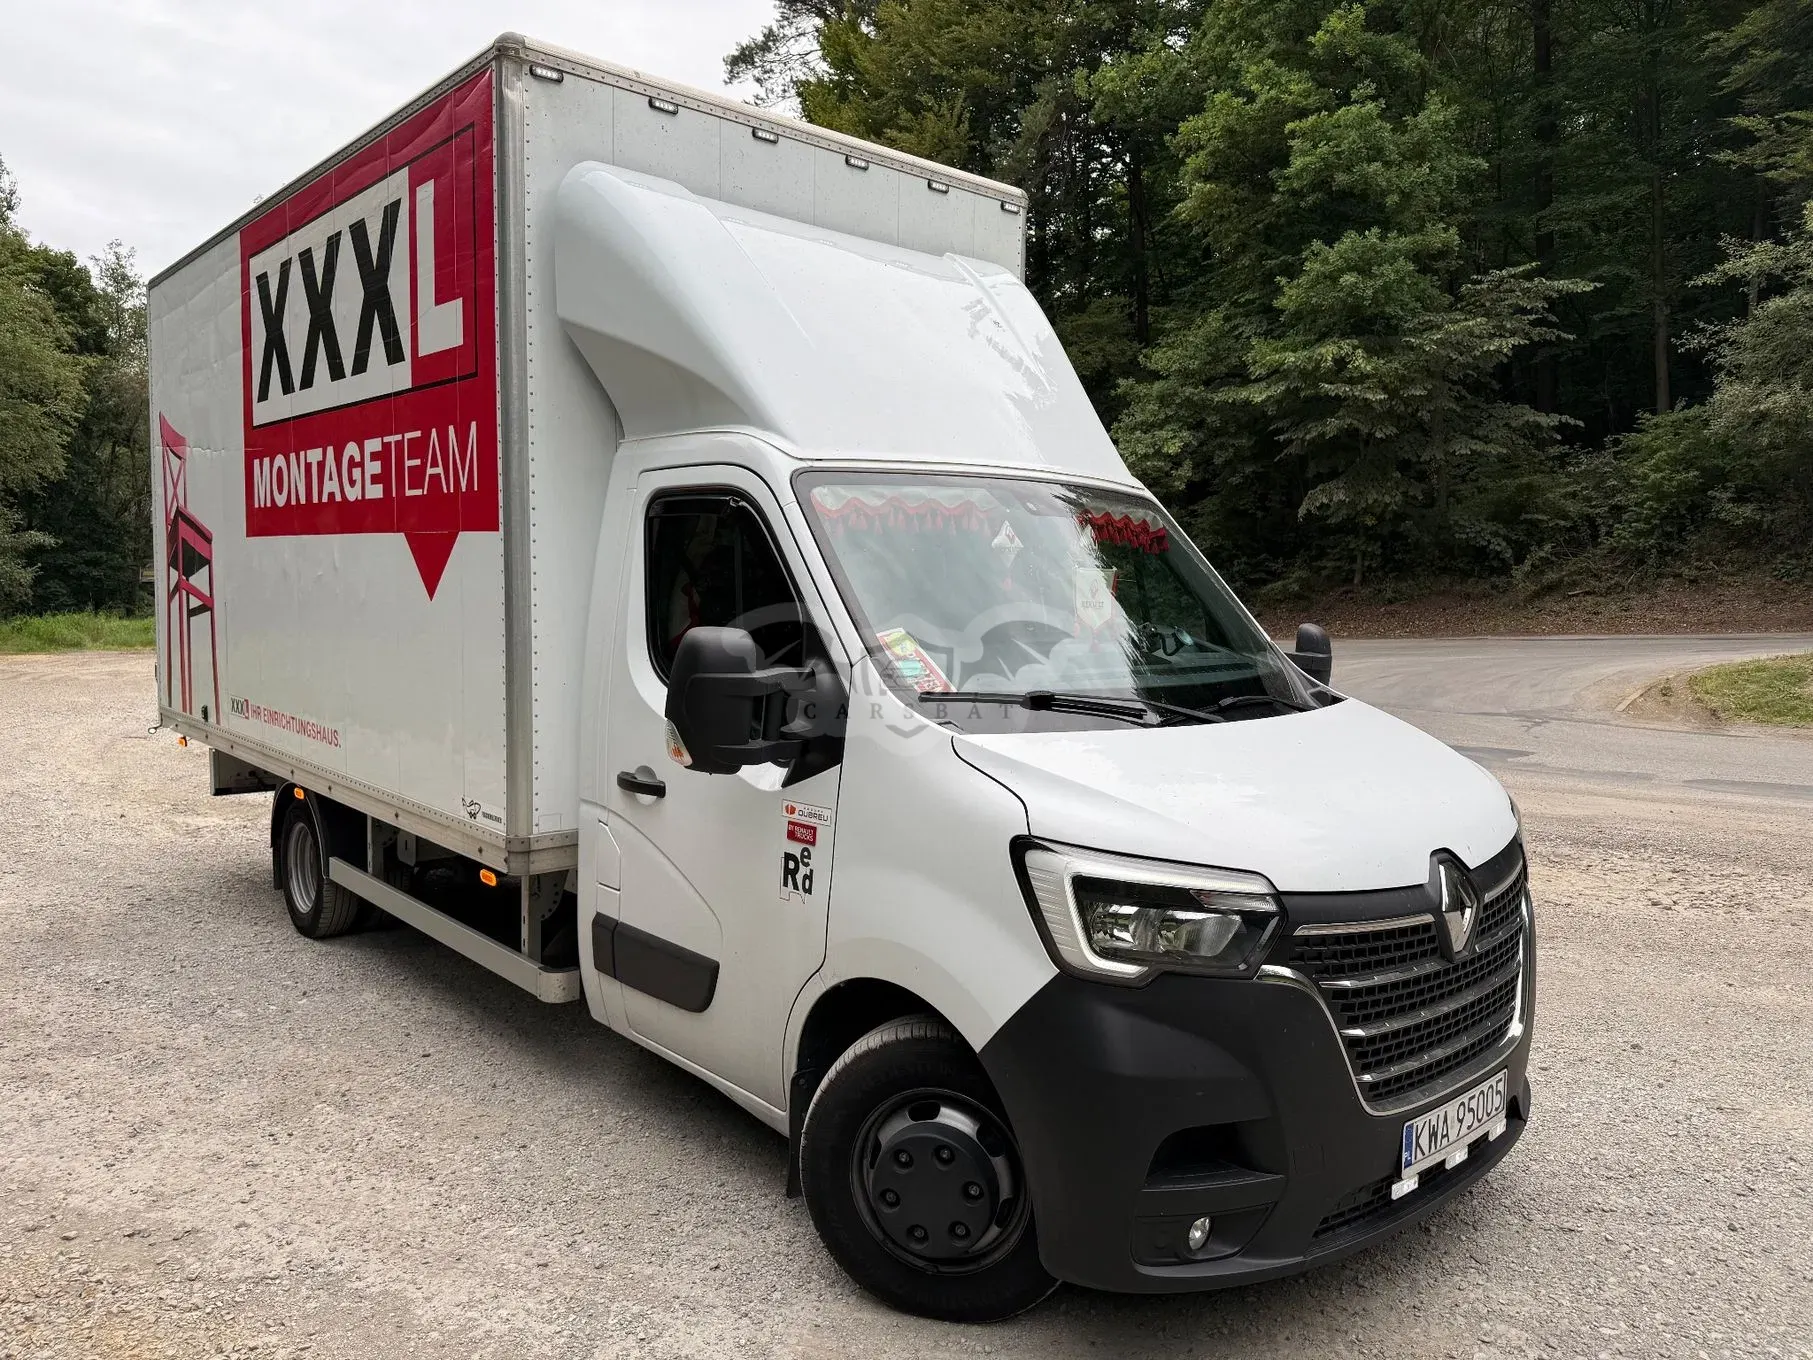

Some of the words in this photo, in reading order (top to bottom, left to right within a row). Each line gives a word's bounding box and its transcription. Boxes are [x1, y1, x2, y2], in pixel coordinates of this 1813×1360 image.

[256, 178, 464, 404] XXXL
[253, 420, 478, 508] MONTAGETEAM
[250, 704, 261, 721] IHR
[263, 707, 342, 749] EINRICHTUNGSHAUS.
[1414, 1110, 1450, 1160] KWA
[1456, 1078, 1503, 1137] 95005
